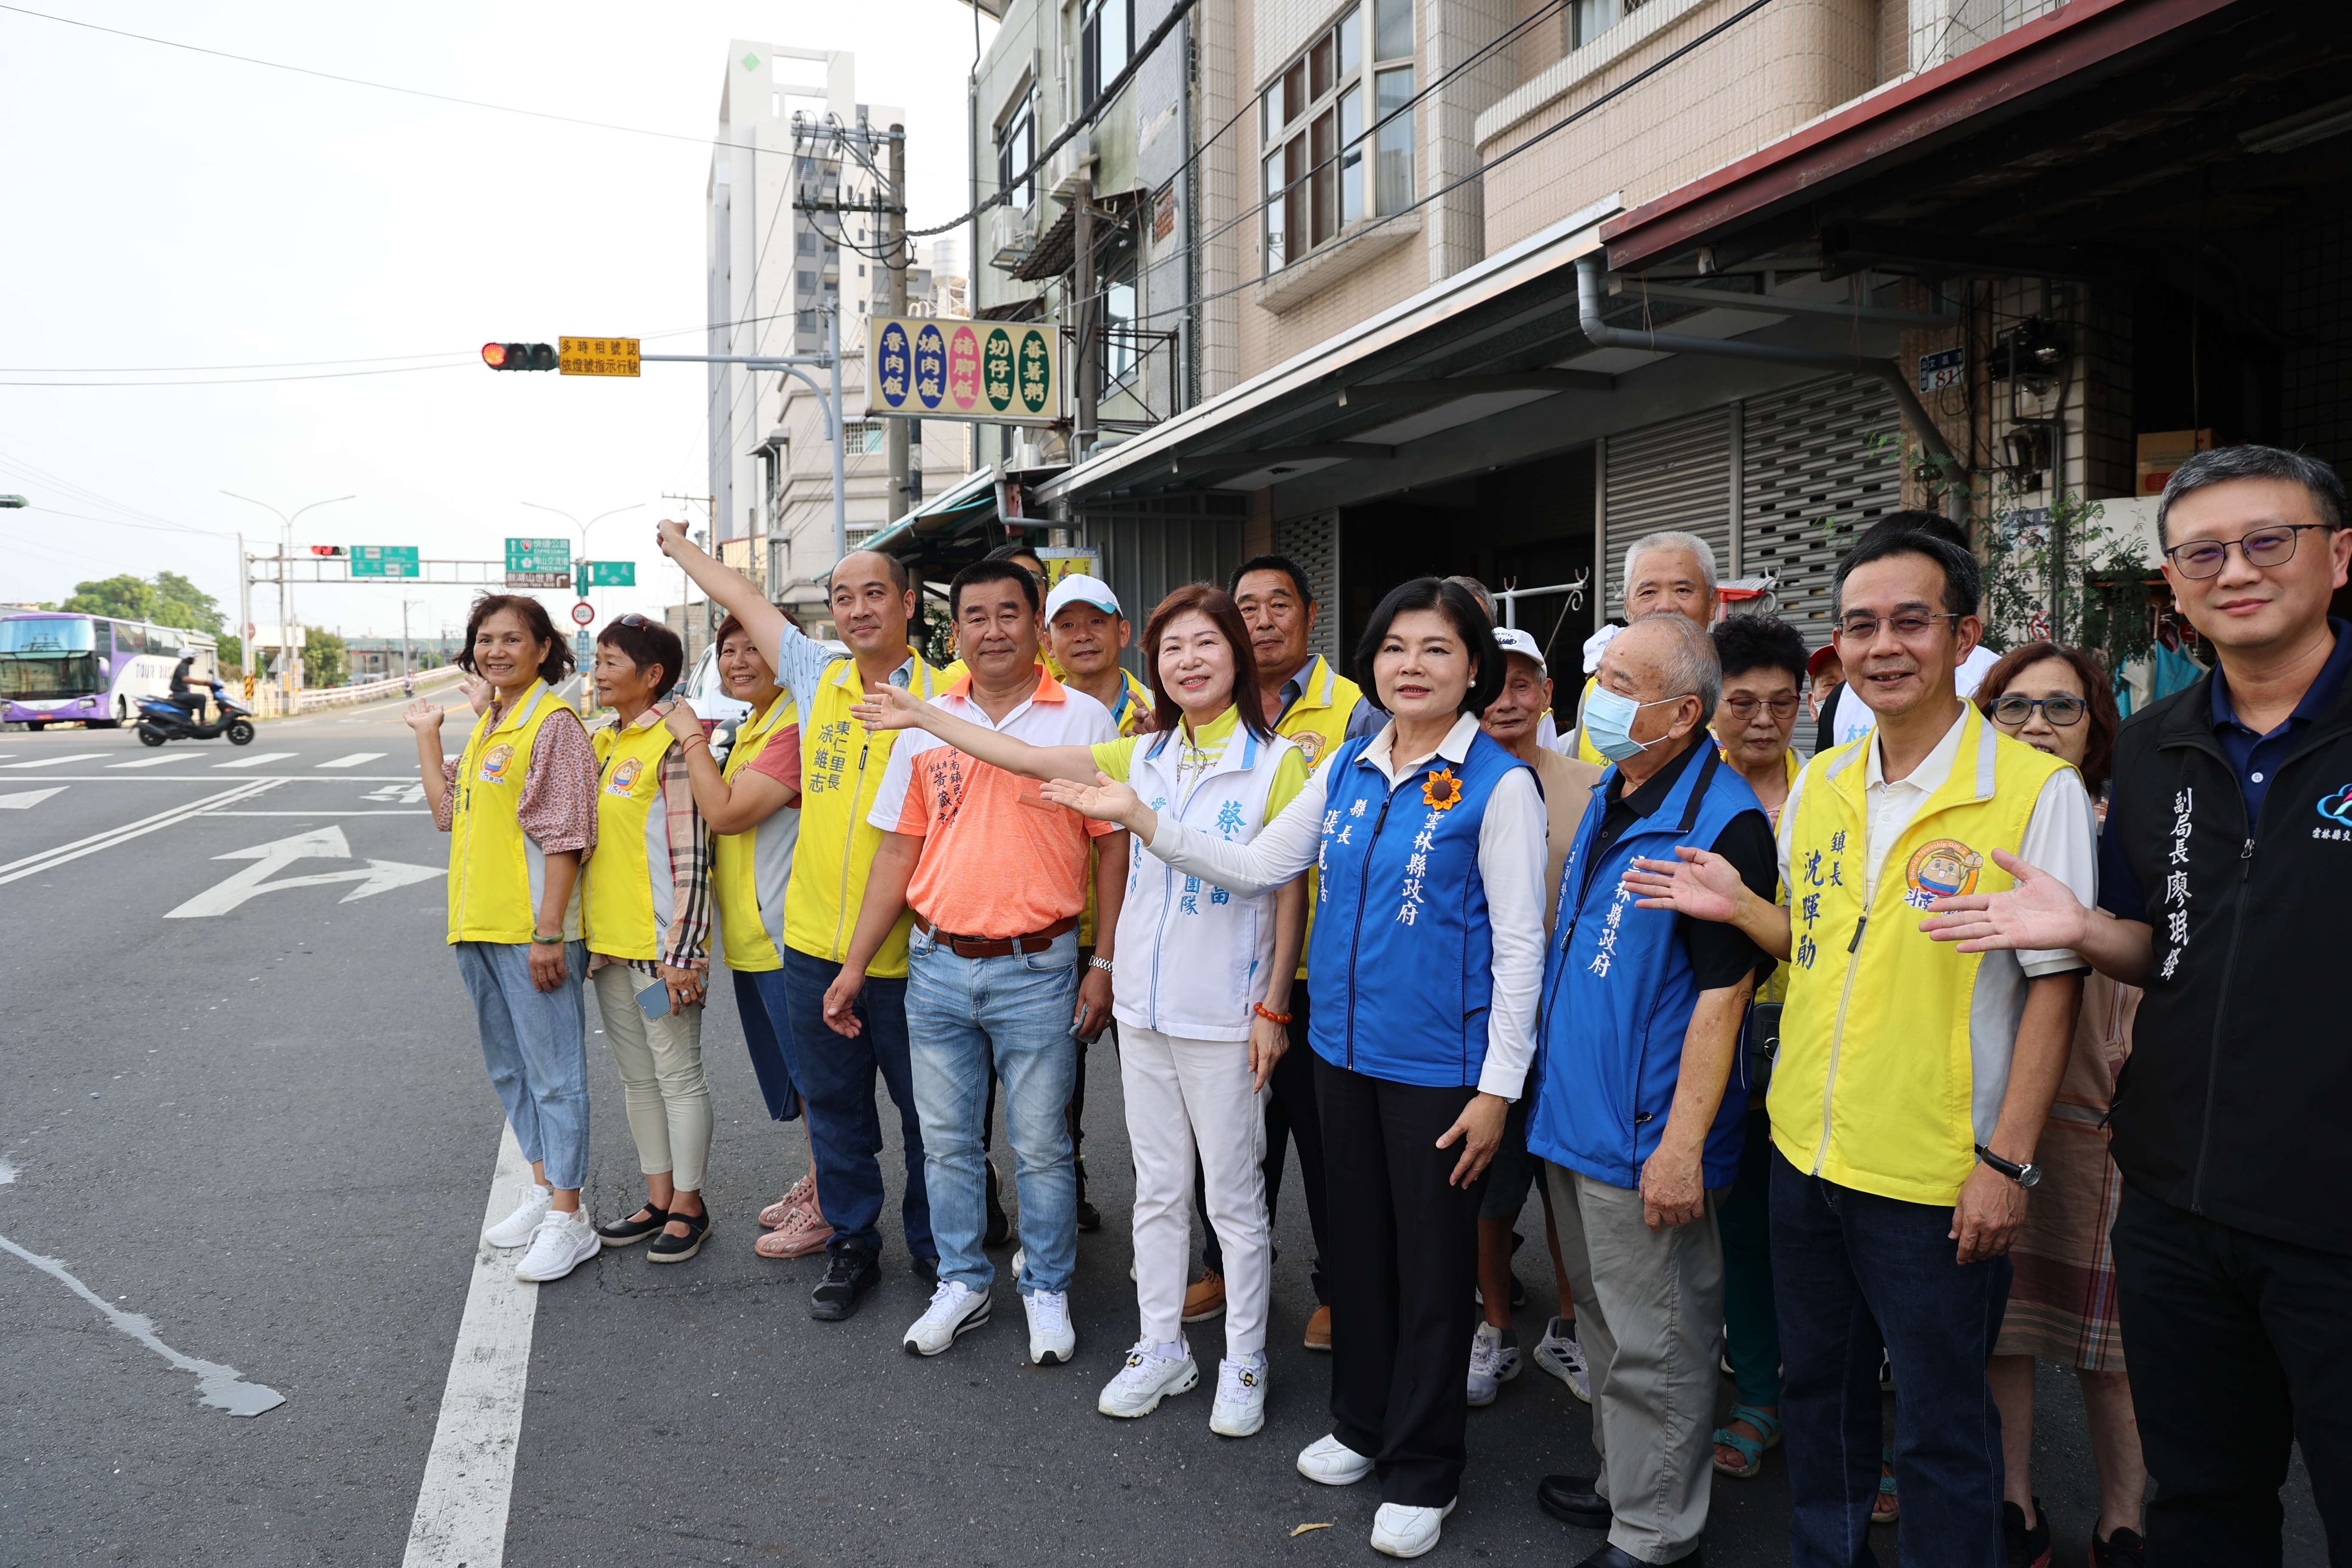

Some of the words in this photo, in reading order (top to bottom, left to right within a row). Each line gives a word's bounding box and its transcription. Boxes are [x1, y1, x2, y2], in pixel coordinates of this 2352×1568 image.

[561, 340, 638, 355] 多時相號誌
[561, 358, 638, 374] 依燈號指示行駛
[918, 334, 943, 398] 爌肉飯
[988, 338, 1011, 401] 切仔麵
[1936, 370, 1954, 387] 81
[136, 663, 155, 678] TOUR
[827, 720, 851, 790] 東仁里長
[930, 760, 948, 772] 副主席
[1336, 799, 1368, 845] 縣長
[2312, 827, 2352, 841] 雲林縣交
[1396, 811, 1446, 926] 雲林縣政府
[1830, 829, 1846, 887] 鎮長
[1910, 856, 1918, 880] Dounan
[1918, 842, 1947, 856] Township
[1948, 842, 1967, 854] Office
